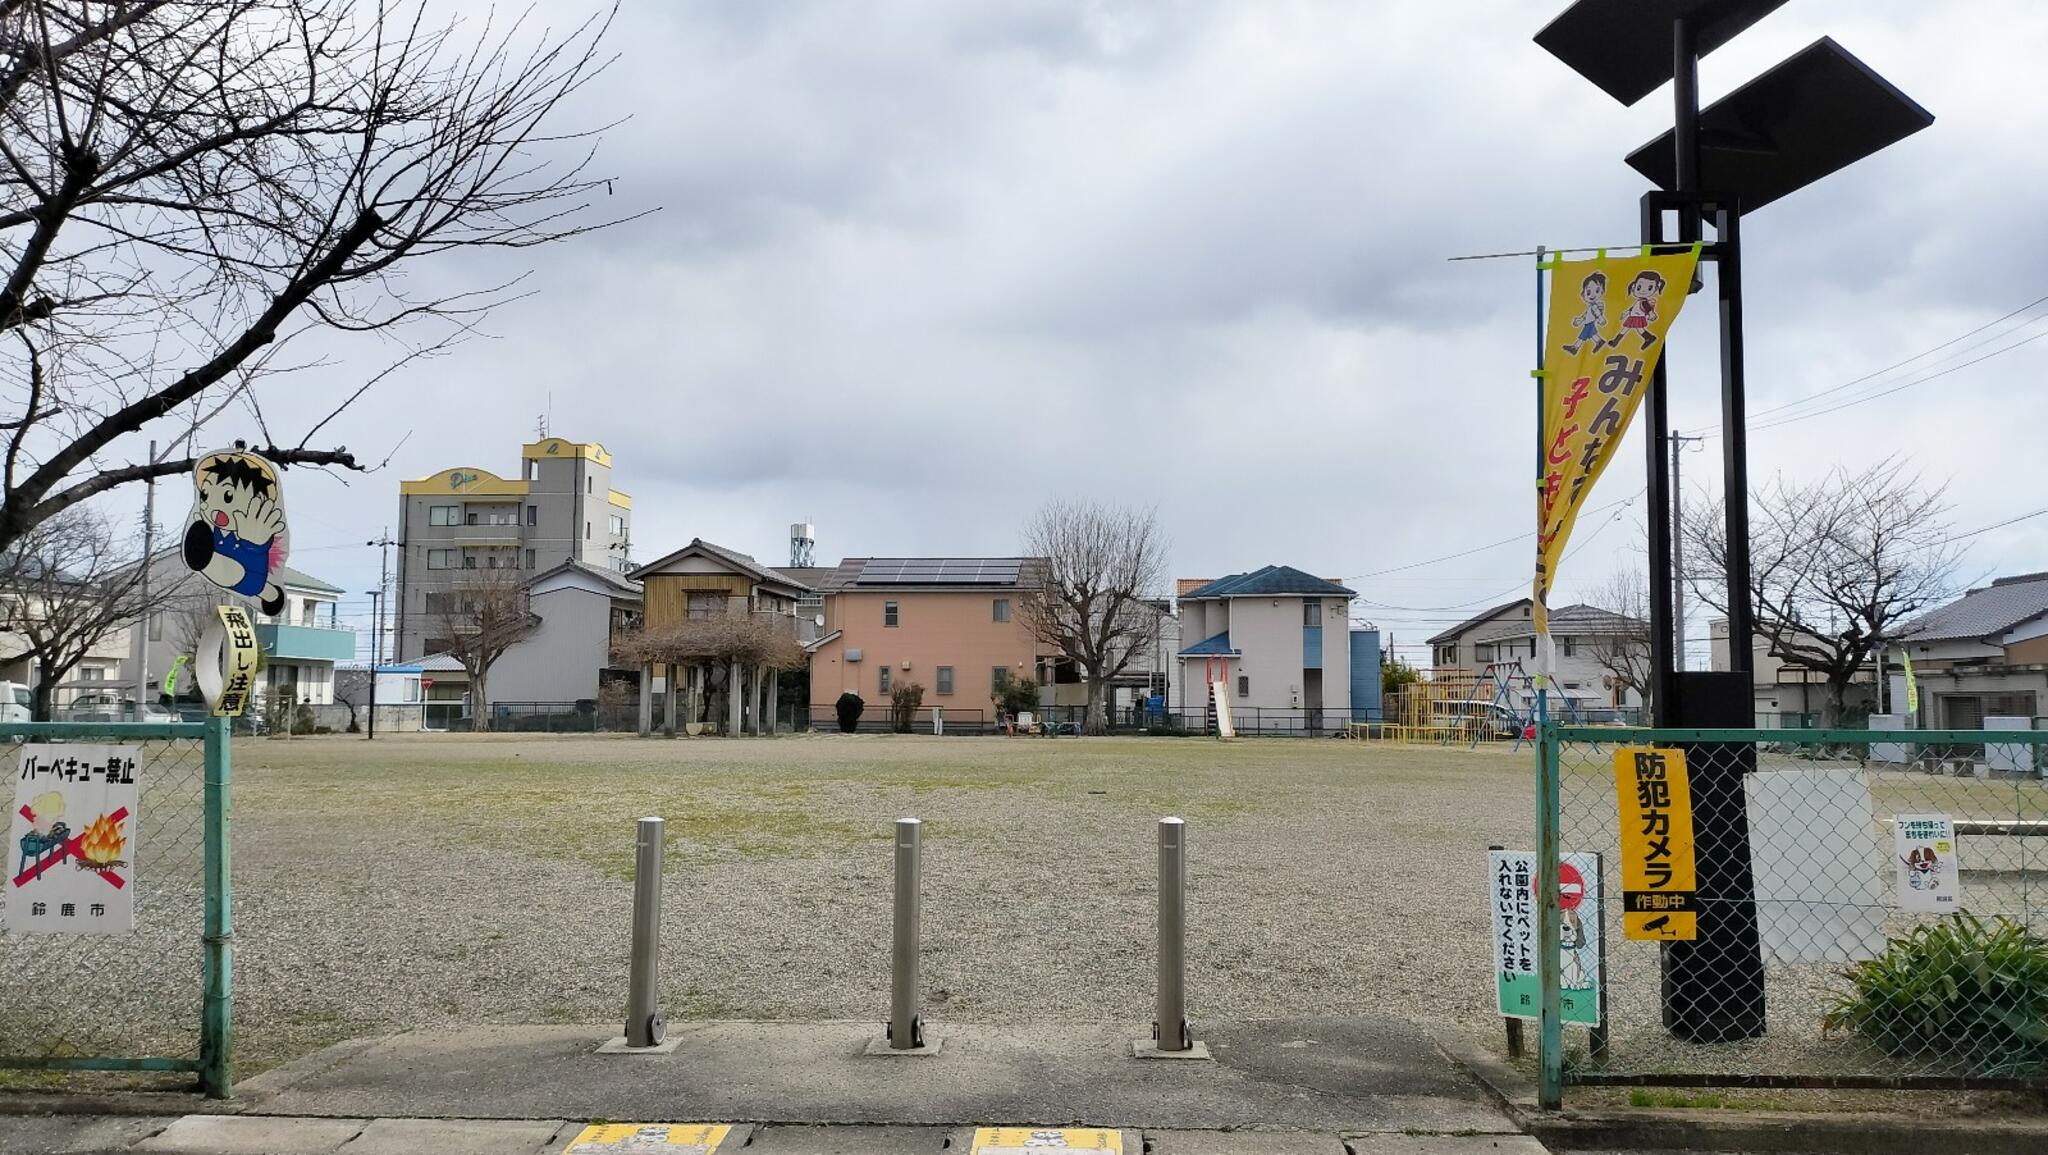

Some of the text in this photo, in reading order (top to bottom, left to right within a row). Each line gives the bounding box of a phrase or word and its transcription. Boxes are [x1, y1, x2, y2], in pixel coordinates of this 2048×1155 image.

[219, 612, 253, 711] 飛出し注意
[21, 755, 135, 784] バーベキュー禁止
[1634, 752, 1673, 889] 防犯カメラ
[32, 902, 105, 918] 鈴鹿市
[1498, 859, 1516, 983] 入れないでください
[1515, 860, 1532, 972] 公園内にペットを
[1635, 894, 1685, 910] 作動中
